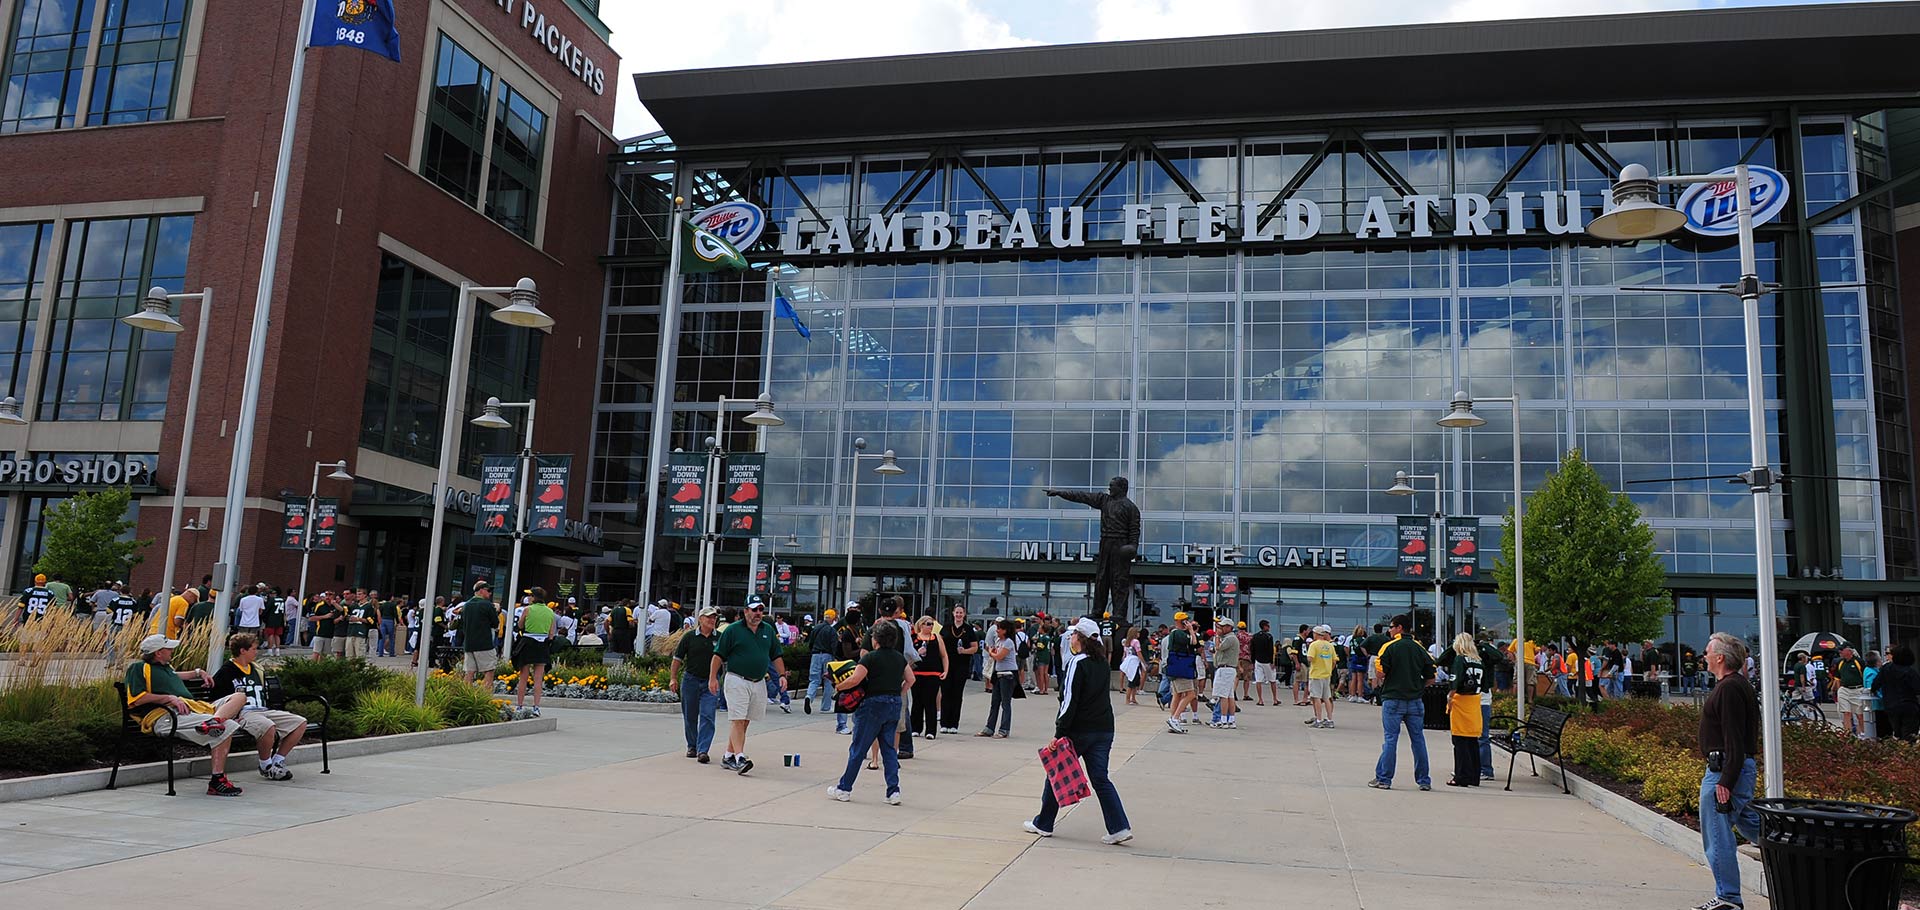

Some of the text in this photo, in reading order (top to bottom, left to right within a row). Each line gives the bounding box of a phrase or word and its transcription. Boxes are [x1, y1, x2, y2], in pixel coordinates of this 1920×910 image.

[336, 27, 365, 44] 1848
[520, 1, 605, 96] PACKERS
[1702, 184, 1768, 227] Lie
[703, 217, 749, 239] te
[783, 189, 1613, 255] LAMBEAU FIELD ATRIU
[0, 460, 141, 484] PRO SHOP
[565, 519, 603, 544] SHOP
[1161, 545, 1235, 565] LITE
[1258, 546, 1347, 568] GATE
[27, 597, 48, 615] 85
[115, 608, 133, 625] 12
[274, 602, 284, 614] 74
[1102, 627, 1112, 636] 85
